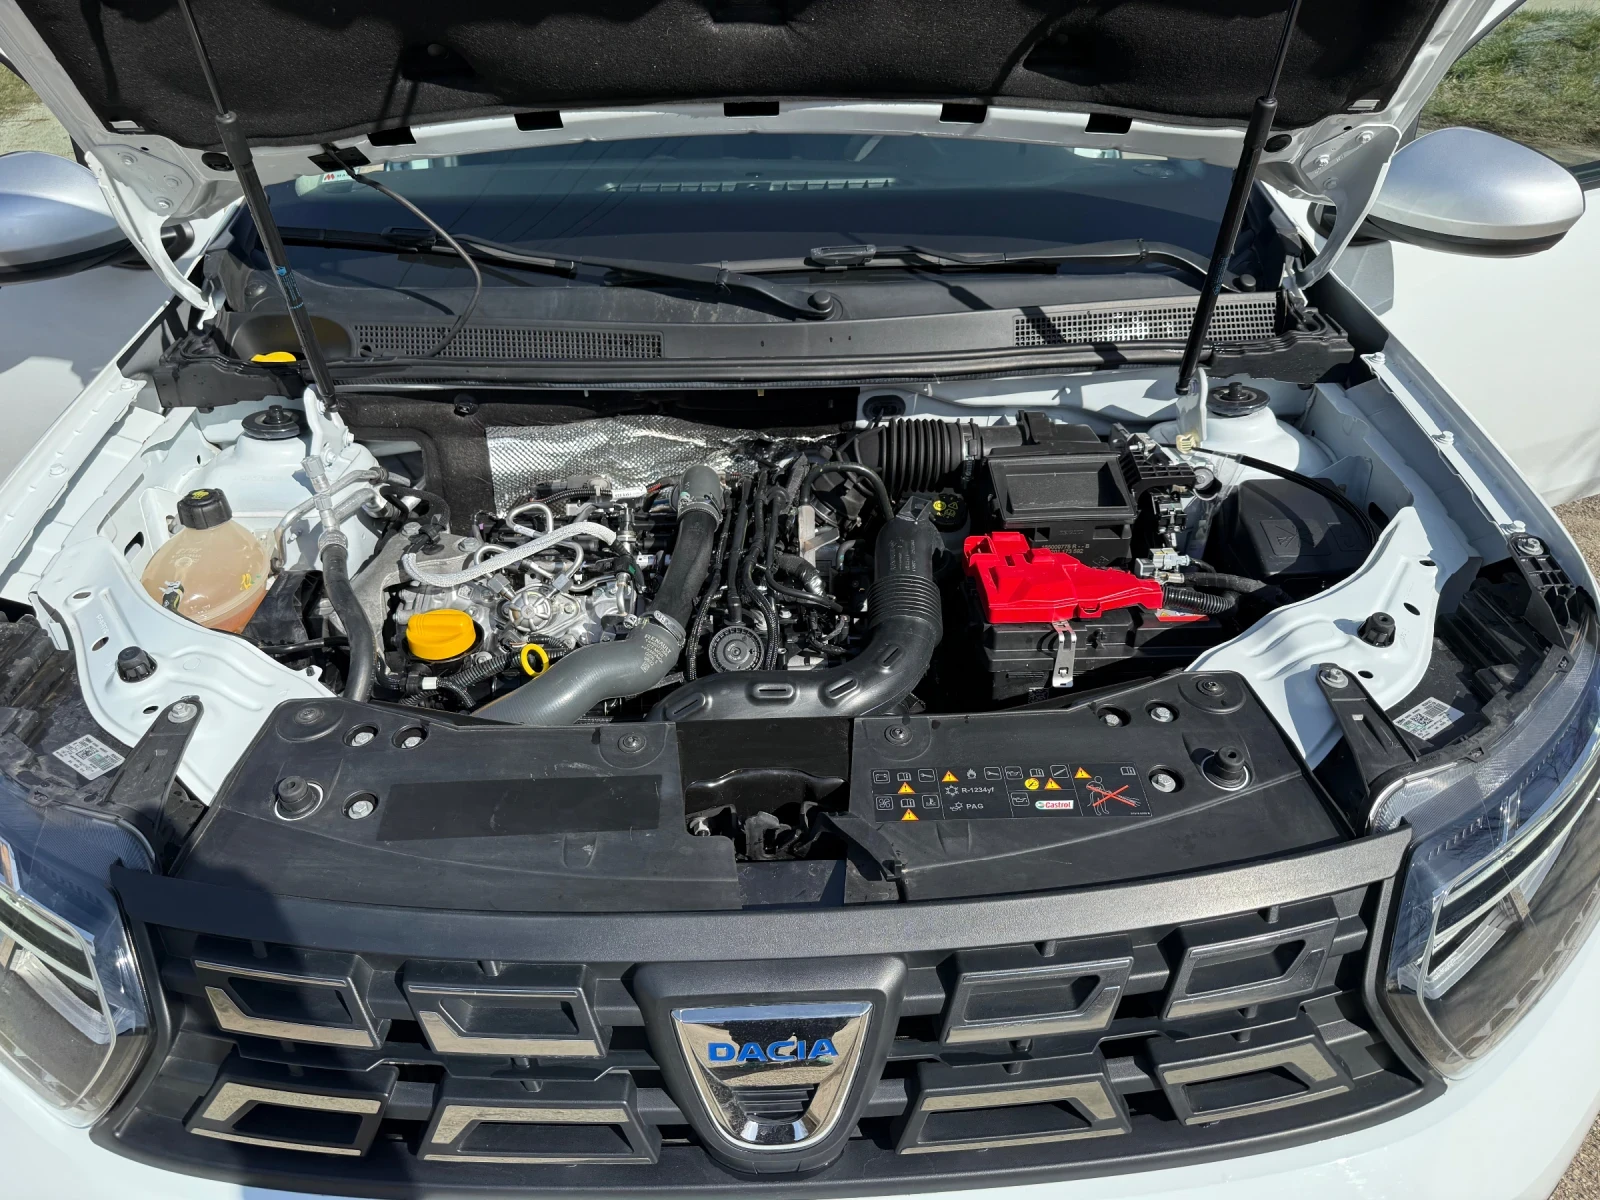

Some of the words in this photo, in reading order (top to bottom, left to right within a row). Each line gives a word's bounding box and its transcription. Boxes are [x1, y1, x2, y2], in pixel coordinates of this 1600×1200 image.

[644, 633, 672, 653] RENAULT
[961, 786, 995, 795] R-1234yf
[965, 802, 984, 810] PAG
[1045, 800, 1072, 809] Castrol
[708, 1038, 839, 1062] DACIA
